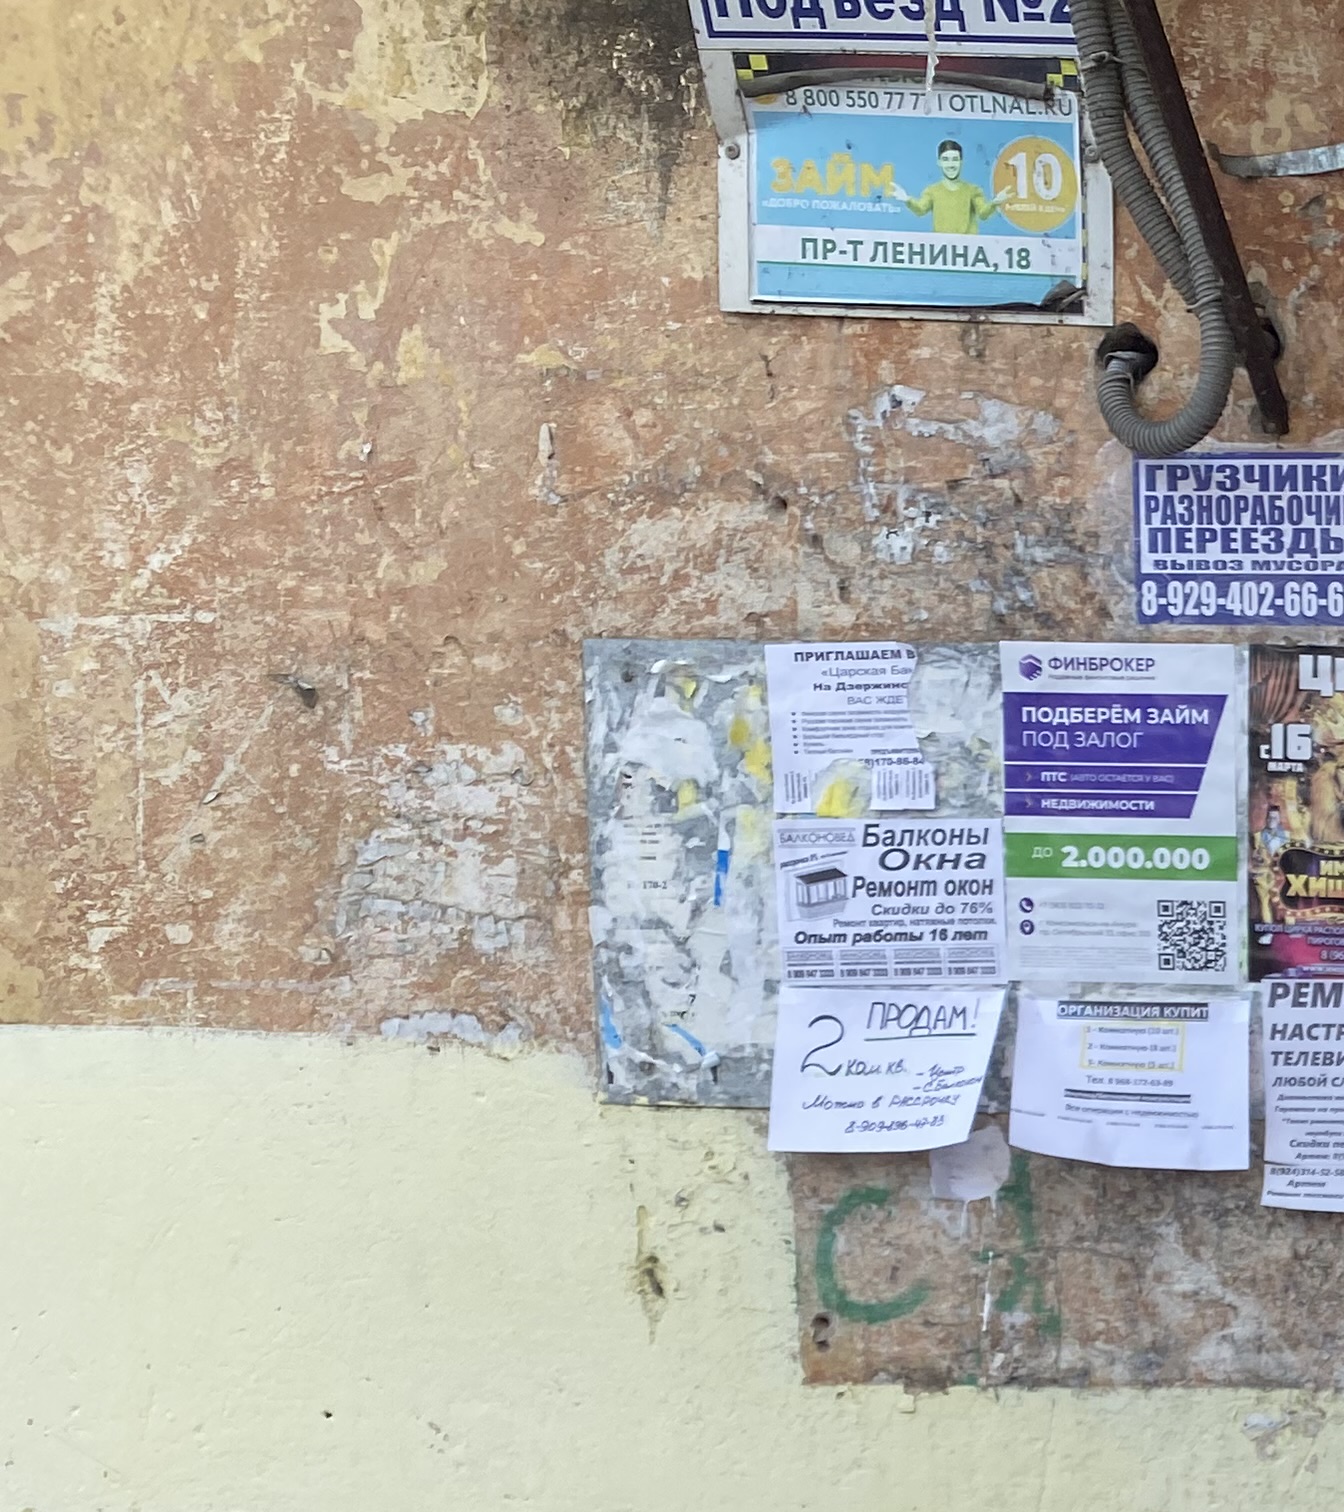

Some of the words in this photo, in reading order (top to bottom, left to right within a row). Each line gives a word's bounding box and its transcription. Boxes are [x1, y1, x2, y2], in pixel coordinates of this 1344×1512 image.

[786, 90, 797, 106] 8
[803, 89, 840, 107] 800
[846, 90, 879, 109] 550
[770, 153, 896, 198] ЗАЙМ
[1009, 152, 1063, 200] 10
[801, 237, 863, 262] ПР-Т
[870, 241, 998, 272] ЛЕНИНА,
[1005, 247, 1031, 270] 18
[1153, 559, 1244, 571] ВЫВОЗ
[794, 650, 902, 662] ПРИГЛАШАЕМ
[1048, 656, 1155, 672] ФИНБРОКЕР
[821, 666, 886, 678] «Царская
[813, 682, 831, 691] На
[847, 696, 872, 705] ВАС
[1021, 704, 1141, 726] ПОДБЕРЁМ
[1146, 704, 1209, 725] ЗАЙМ
[1023, 731, 1069, 750] ПОД
[1073, 731, 1144, 749] ЗАЛОГ
[1271, 723, 1312, 760] 16
[1041, 771, 1067, 782] ПТС
[1041, 799, 1155, 811] НЕДВИЖИМОСТИ
[862, 823, 989, 847] Балконы
[878, 848, 987, 871] Окна
[1032, 847, 1053, 859] ДО
[1061, 845, 1211, 871] 2.000.000
[852, 876, 937, 898] Ремонт
[944, 878, 993, 897] окон
[871, 903, 929, 916] Скидки
[934, 902, 955, 915] до
[960, 902, 993, 914] 76%
[794, 930, 847, 944] Опыт
[851, 929, 924, 946] работы
[929, 928, 947, 941] 16
[951, 929, 989, 941] лет
[866, 998, 981, 1037] ПРОДАМ!
[1057, 1005, 1160, 1019] ОРГАНИЗАЦИЯ
[1163, 1006, 1208, 1018] КУПИТ
[800, 1015, 844, 1076] 2
[1272, 1074, 1328, 1088] ЛЮБОЙ
